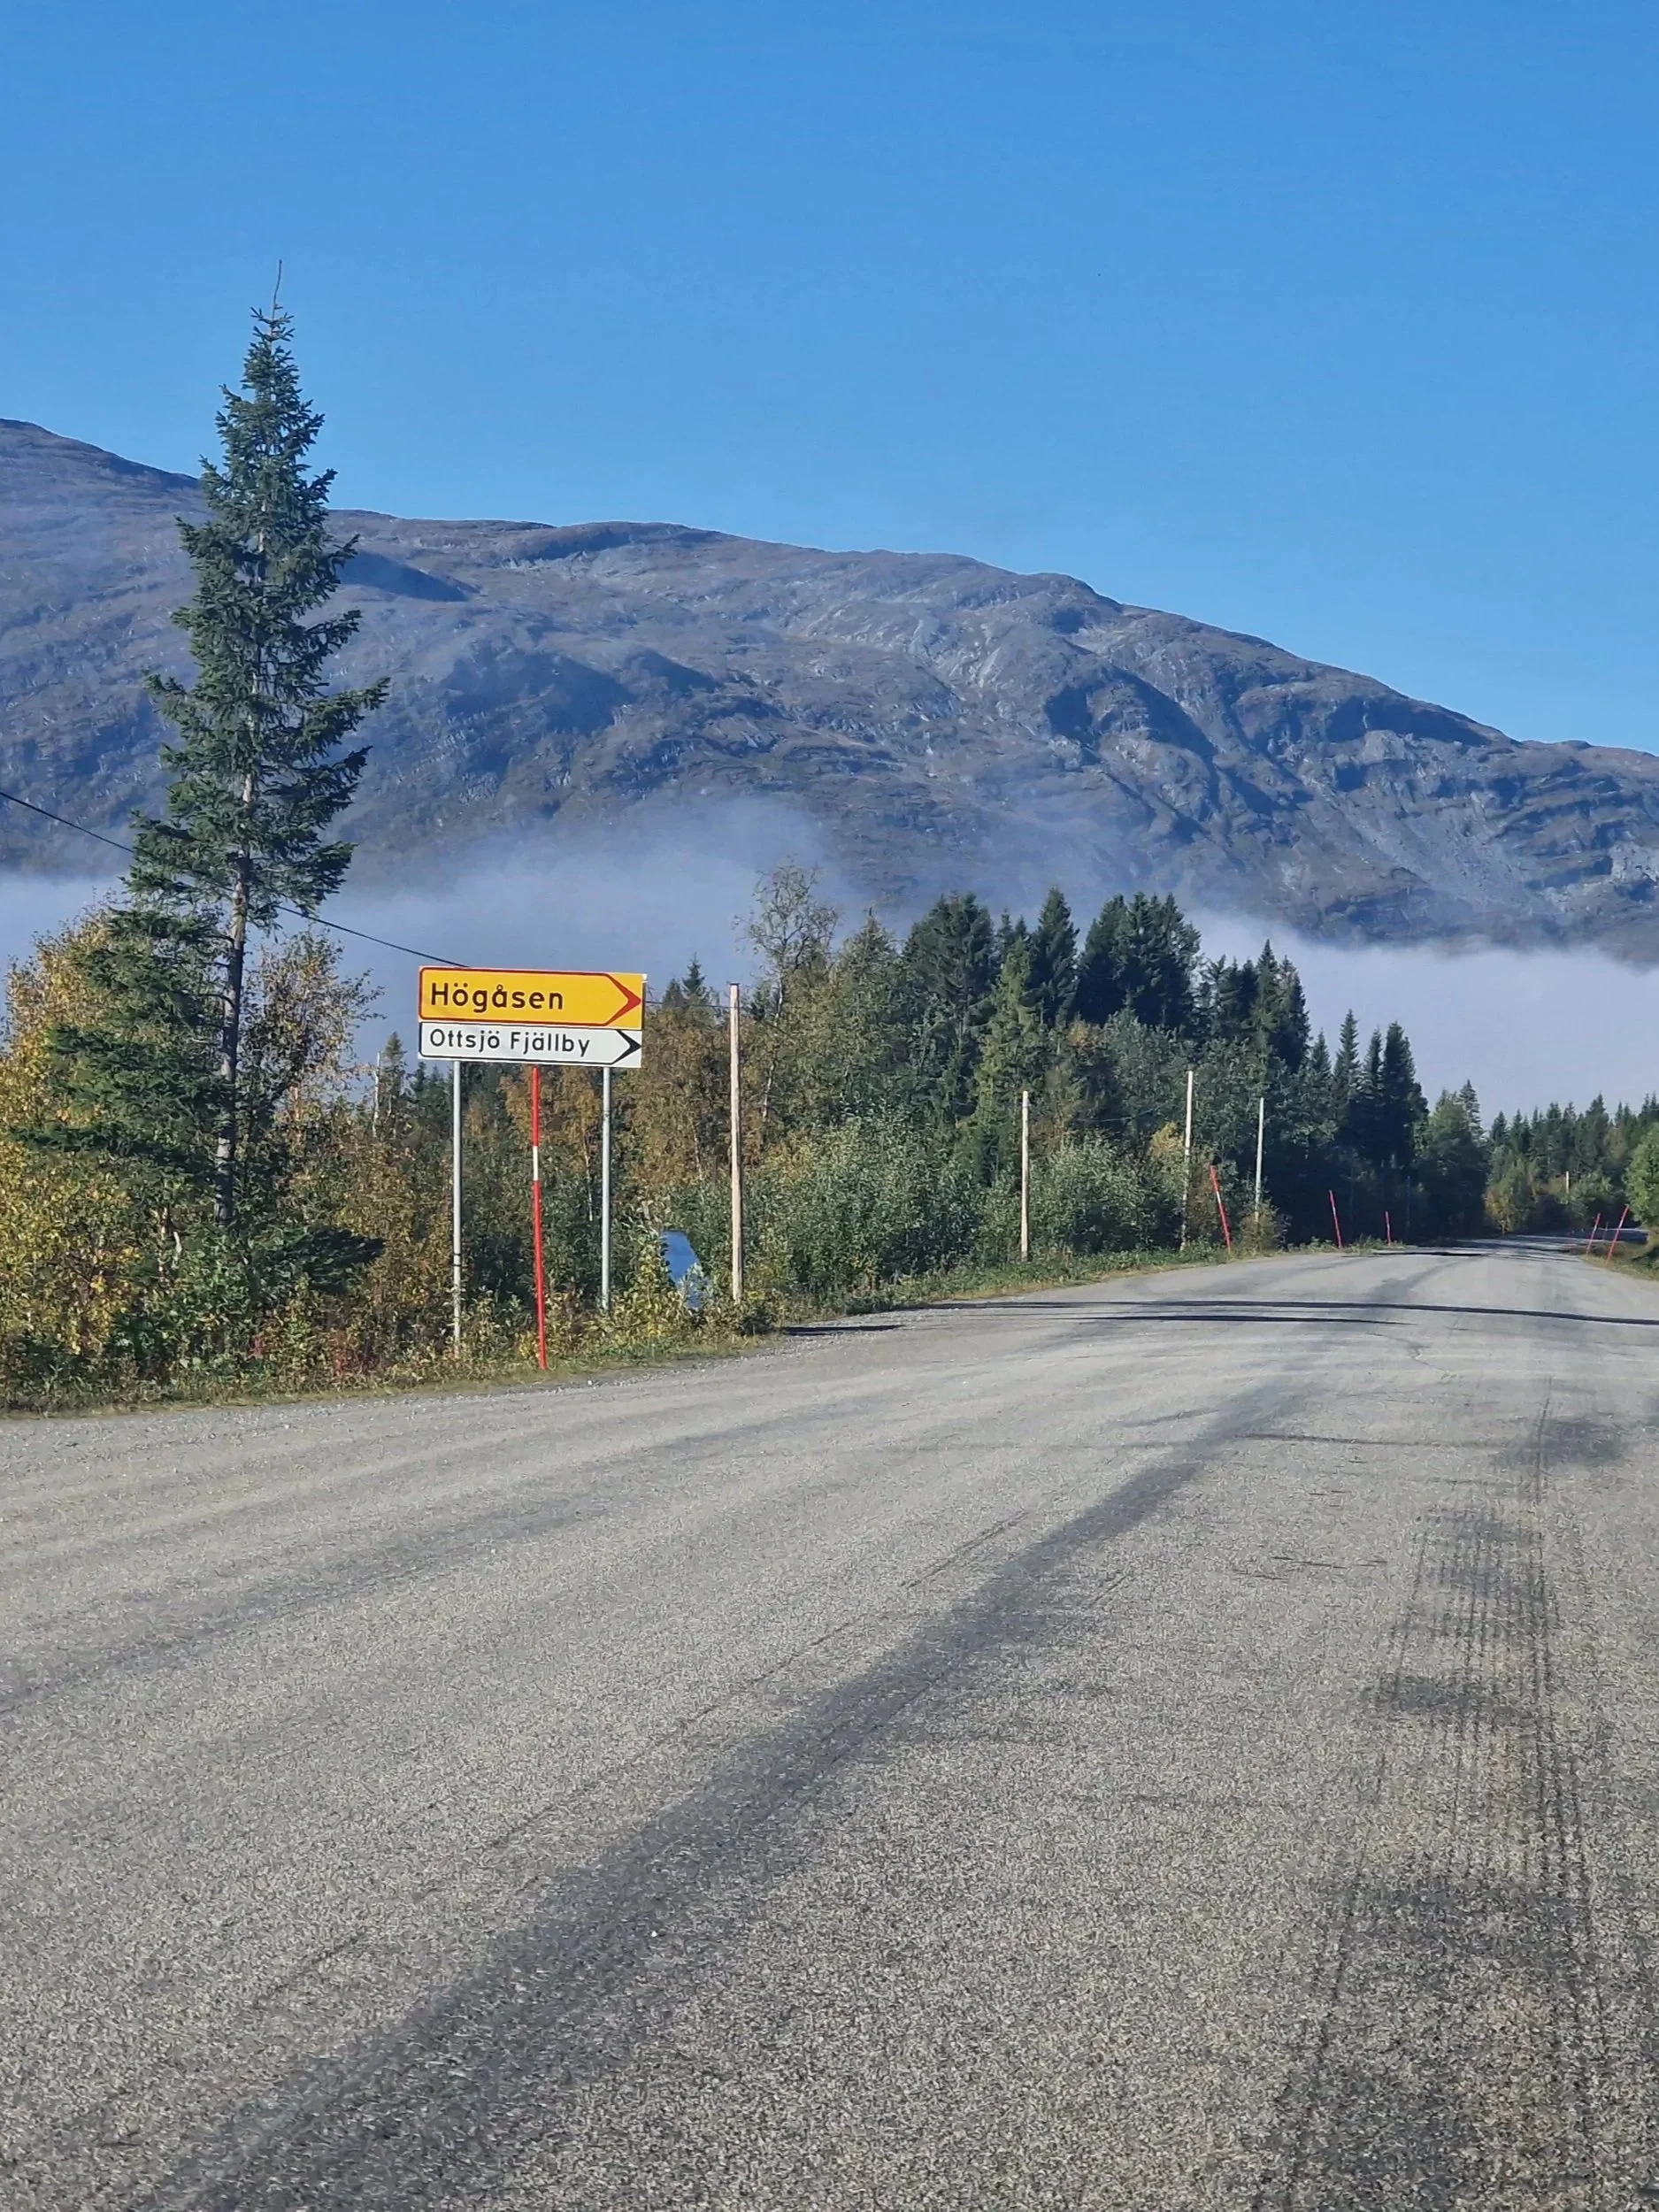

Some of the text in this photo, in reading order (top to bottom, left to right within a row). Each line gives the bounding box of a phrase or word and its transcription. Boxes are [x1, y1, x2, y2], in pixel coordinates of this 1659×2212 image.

[431, 982, 564, 1013] Högåsen
[429, 1028, 590, 1057] Ottsjö Fjällby
